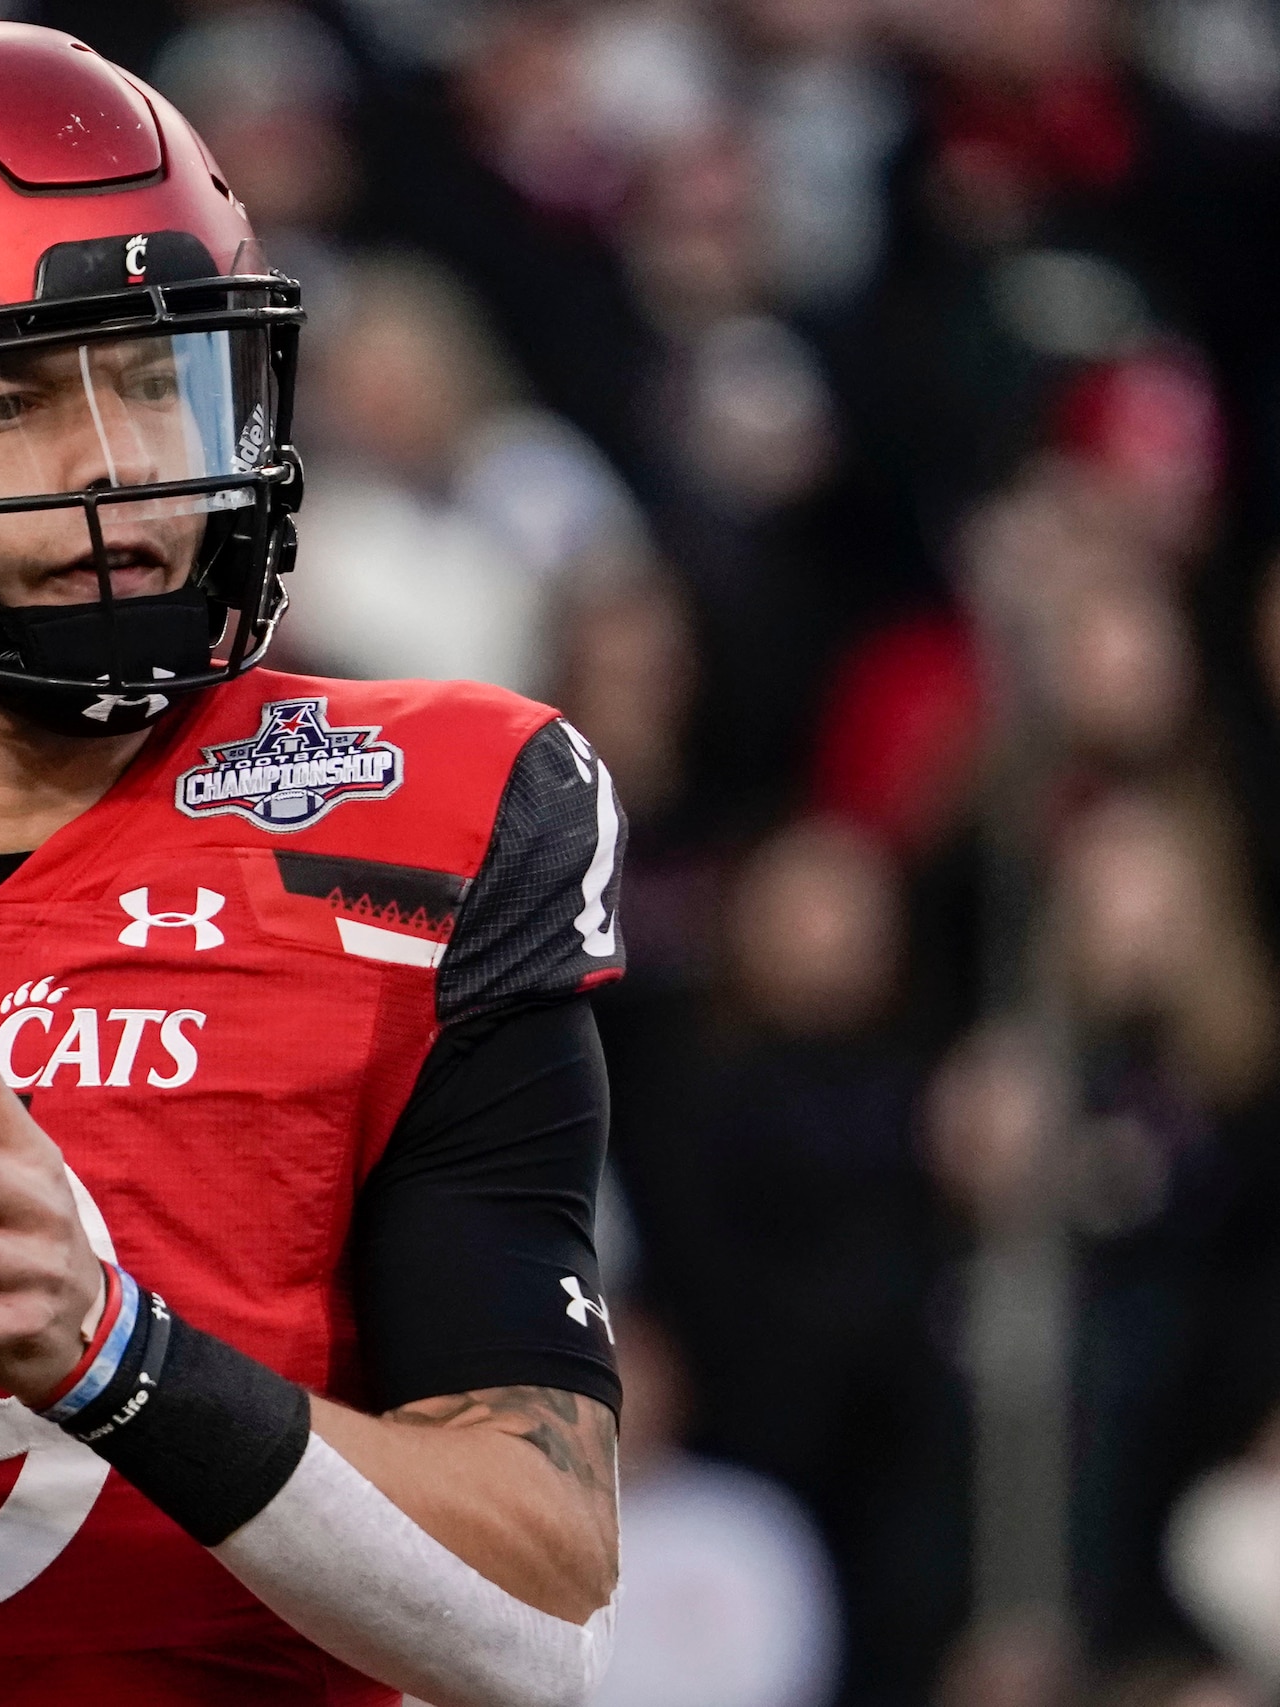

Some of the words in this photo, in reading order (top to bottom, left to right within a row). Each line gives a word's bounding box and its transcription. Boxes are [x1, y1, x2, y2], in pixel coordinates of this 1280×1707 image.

[125, 244, 147, 276] C
[220, 745, 362, 772] FOOTBALL
[185, 750, 393, 804] CHAMPIONSHIP
[112, 1389, 150, 1425] Life
